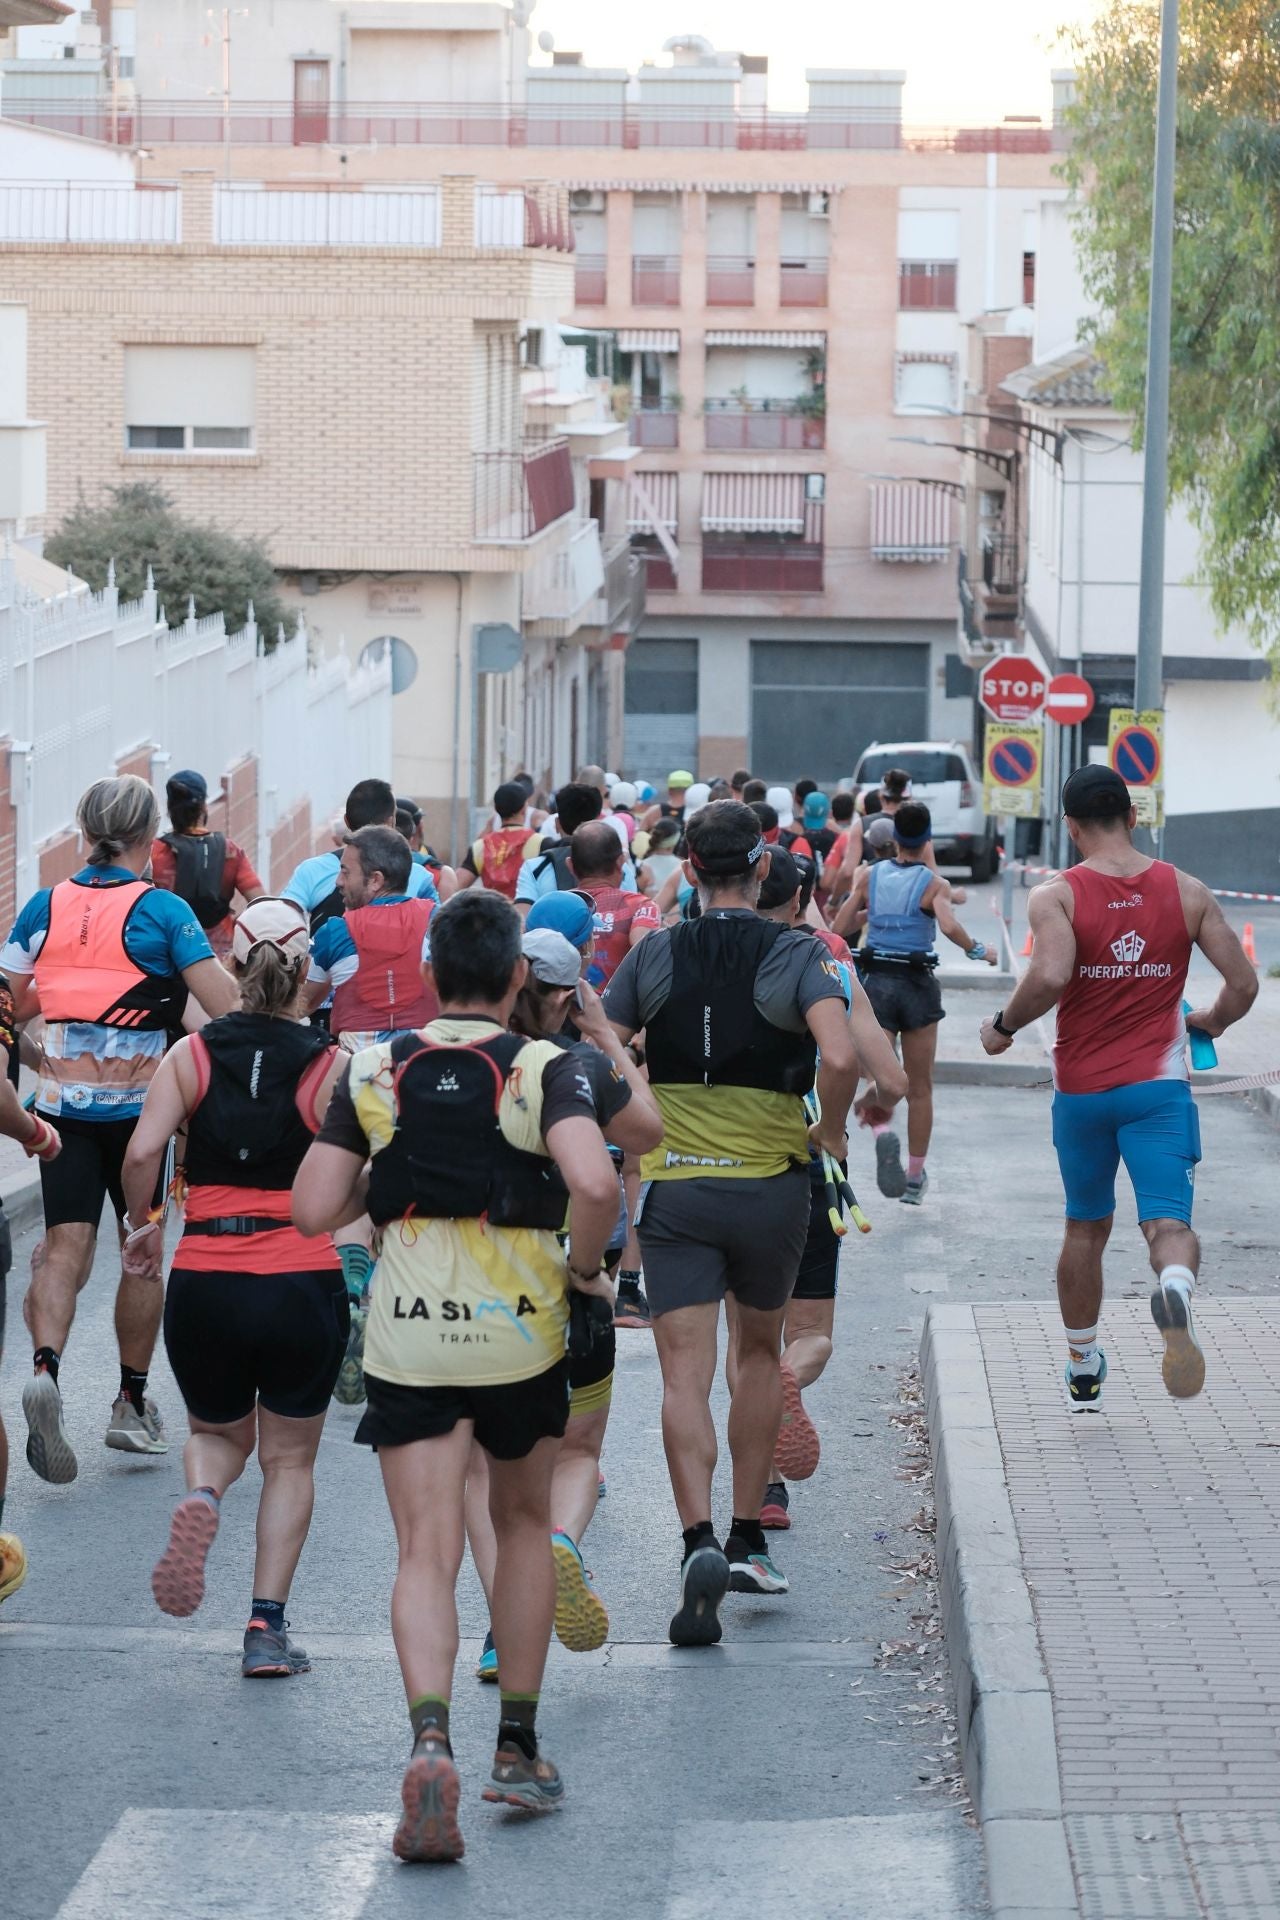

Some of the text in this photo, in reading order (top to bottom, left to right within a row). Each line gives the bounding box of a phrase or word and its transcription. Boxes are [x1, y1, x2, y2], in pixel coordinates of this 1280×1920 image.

[984, 679, 1045, 698] STOP
[80, 915, 89, 947] TERREX
[1080, 963, 1172, 979] PUERTAS LORCA
[249, 1049, 263, 1099] SALOMON
[394, 1296, 431, 1320] LA
[439, 1334, 490, 1344] TRAIL
